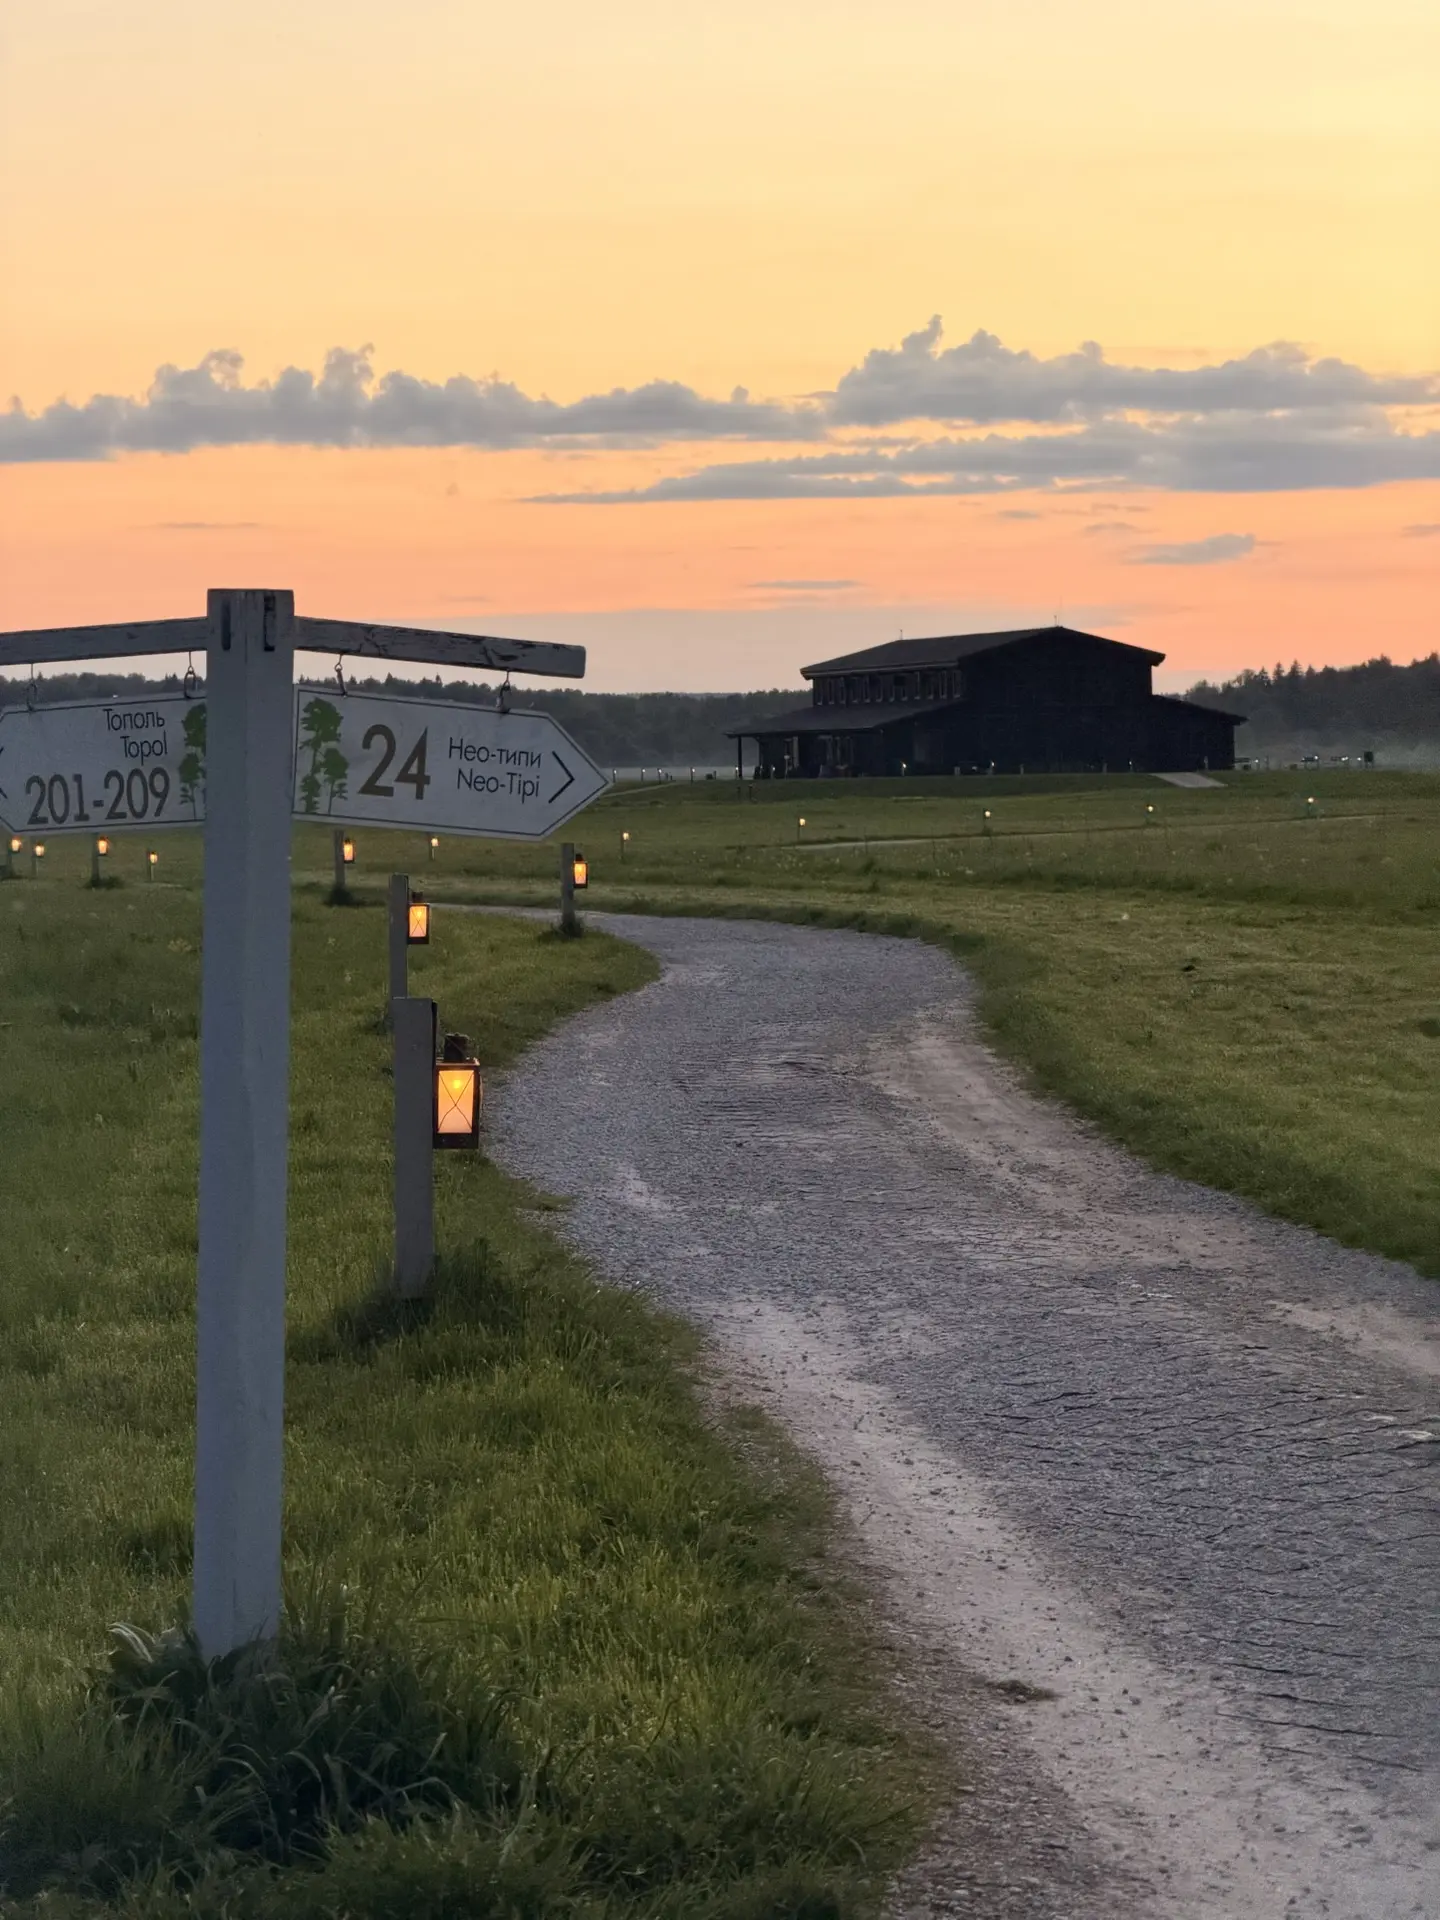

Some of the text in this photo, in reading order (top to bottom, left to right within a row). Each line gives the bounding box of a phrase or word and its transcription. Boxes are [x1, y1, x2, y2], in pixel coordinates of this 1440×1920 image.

[102, 708, 165, 731] Тополь
[120, 730, 168, 766] Topol
[357, 724, 431, 800] 24
[448, 737, 542, 769] Нео-типи
[25, 767, 170, 825] 201-209
[456, 768, 541, 804] Neo-Tipi
